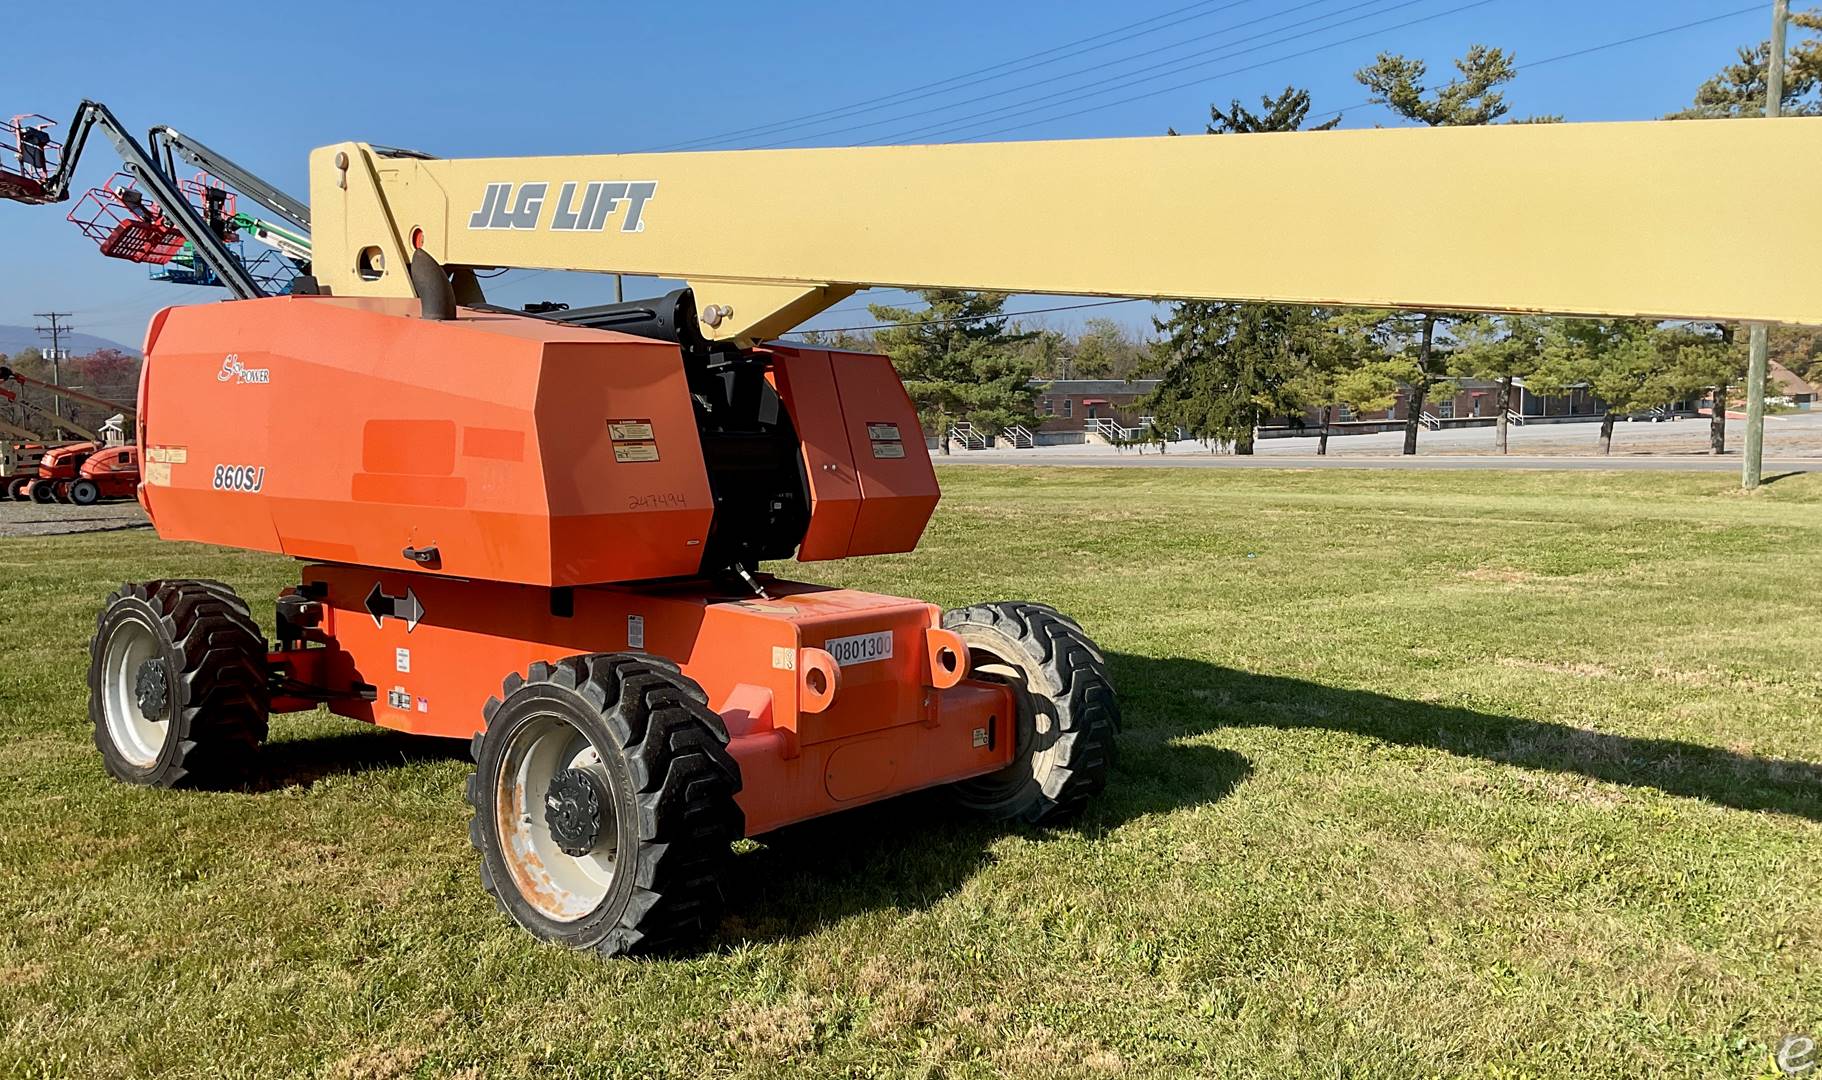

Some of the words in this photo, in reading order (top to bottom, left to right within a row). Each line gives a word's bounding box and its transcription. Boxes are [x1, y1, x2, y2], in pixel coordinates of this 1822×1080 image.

[468, 182, 549, 230] JLG
[550, 181, 658, 232] LIFT
[240, 368, 270, 384] POWER
[213, 464, 264, 493] 860SJ
